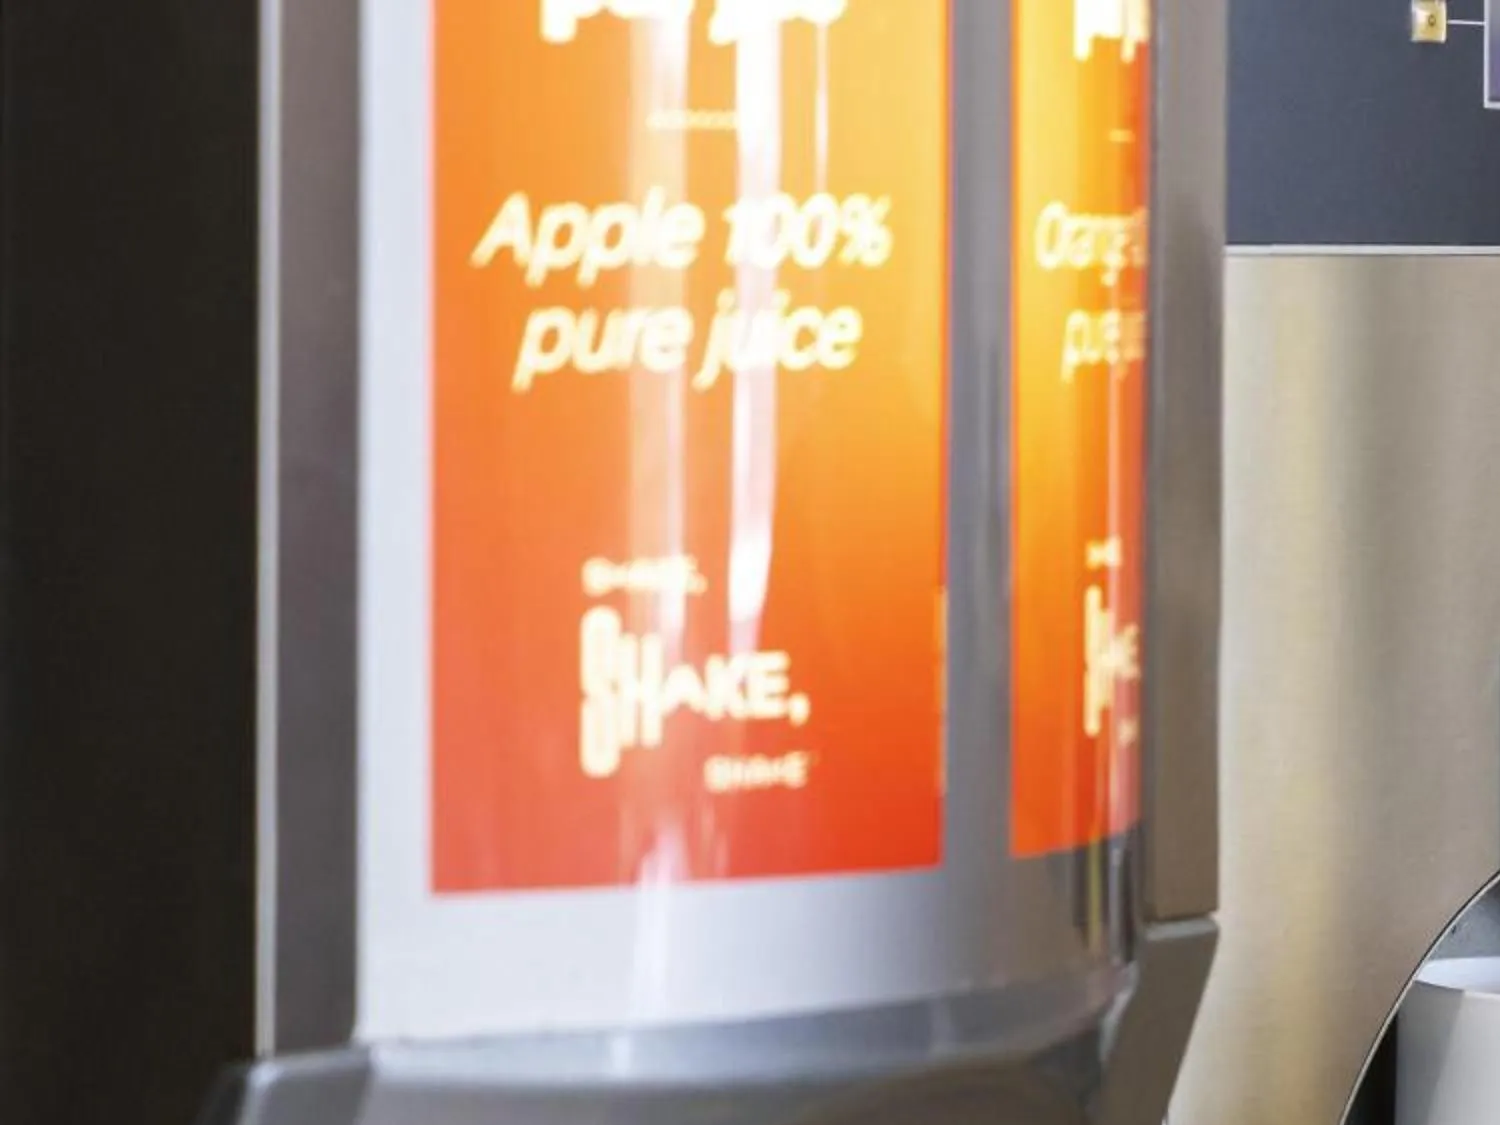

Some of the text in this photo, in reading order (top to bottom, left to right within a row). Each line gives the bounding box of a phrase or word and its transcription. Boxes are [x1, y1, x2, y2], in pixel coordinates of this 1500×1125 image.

[470, 186, 893, 288] Apple 100%
[512, 288, 863, 392] pure juice
